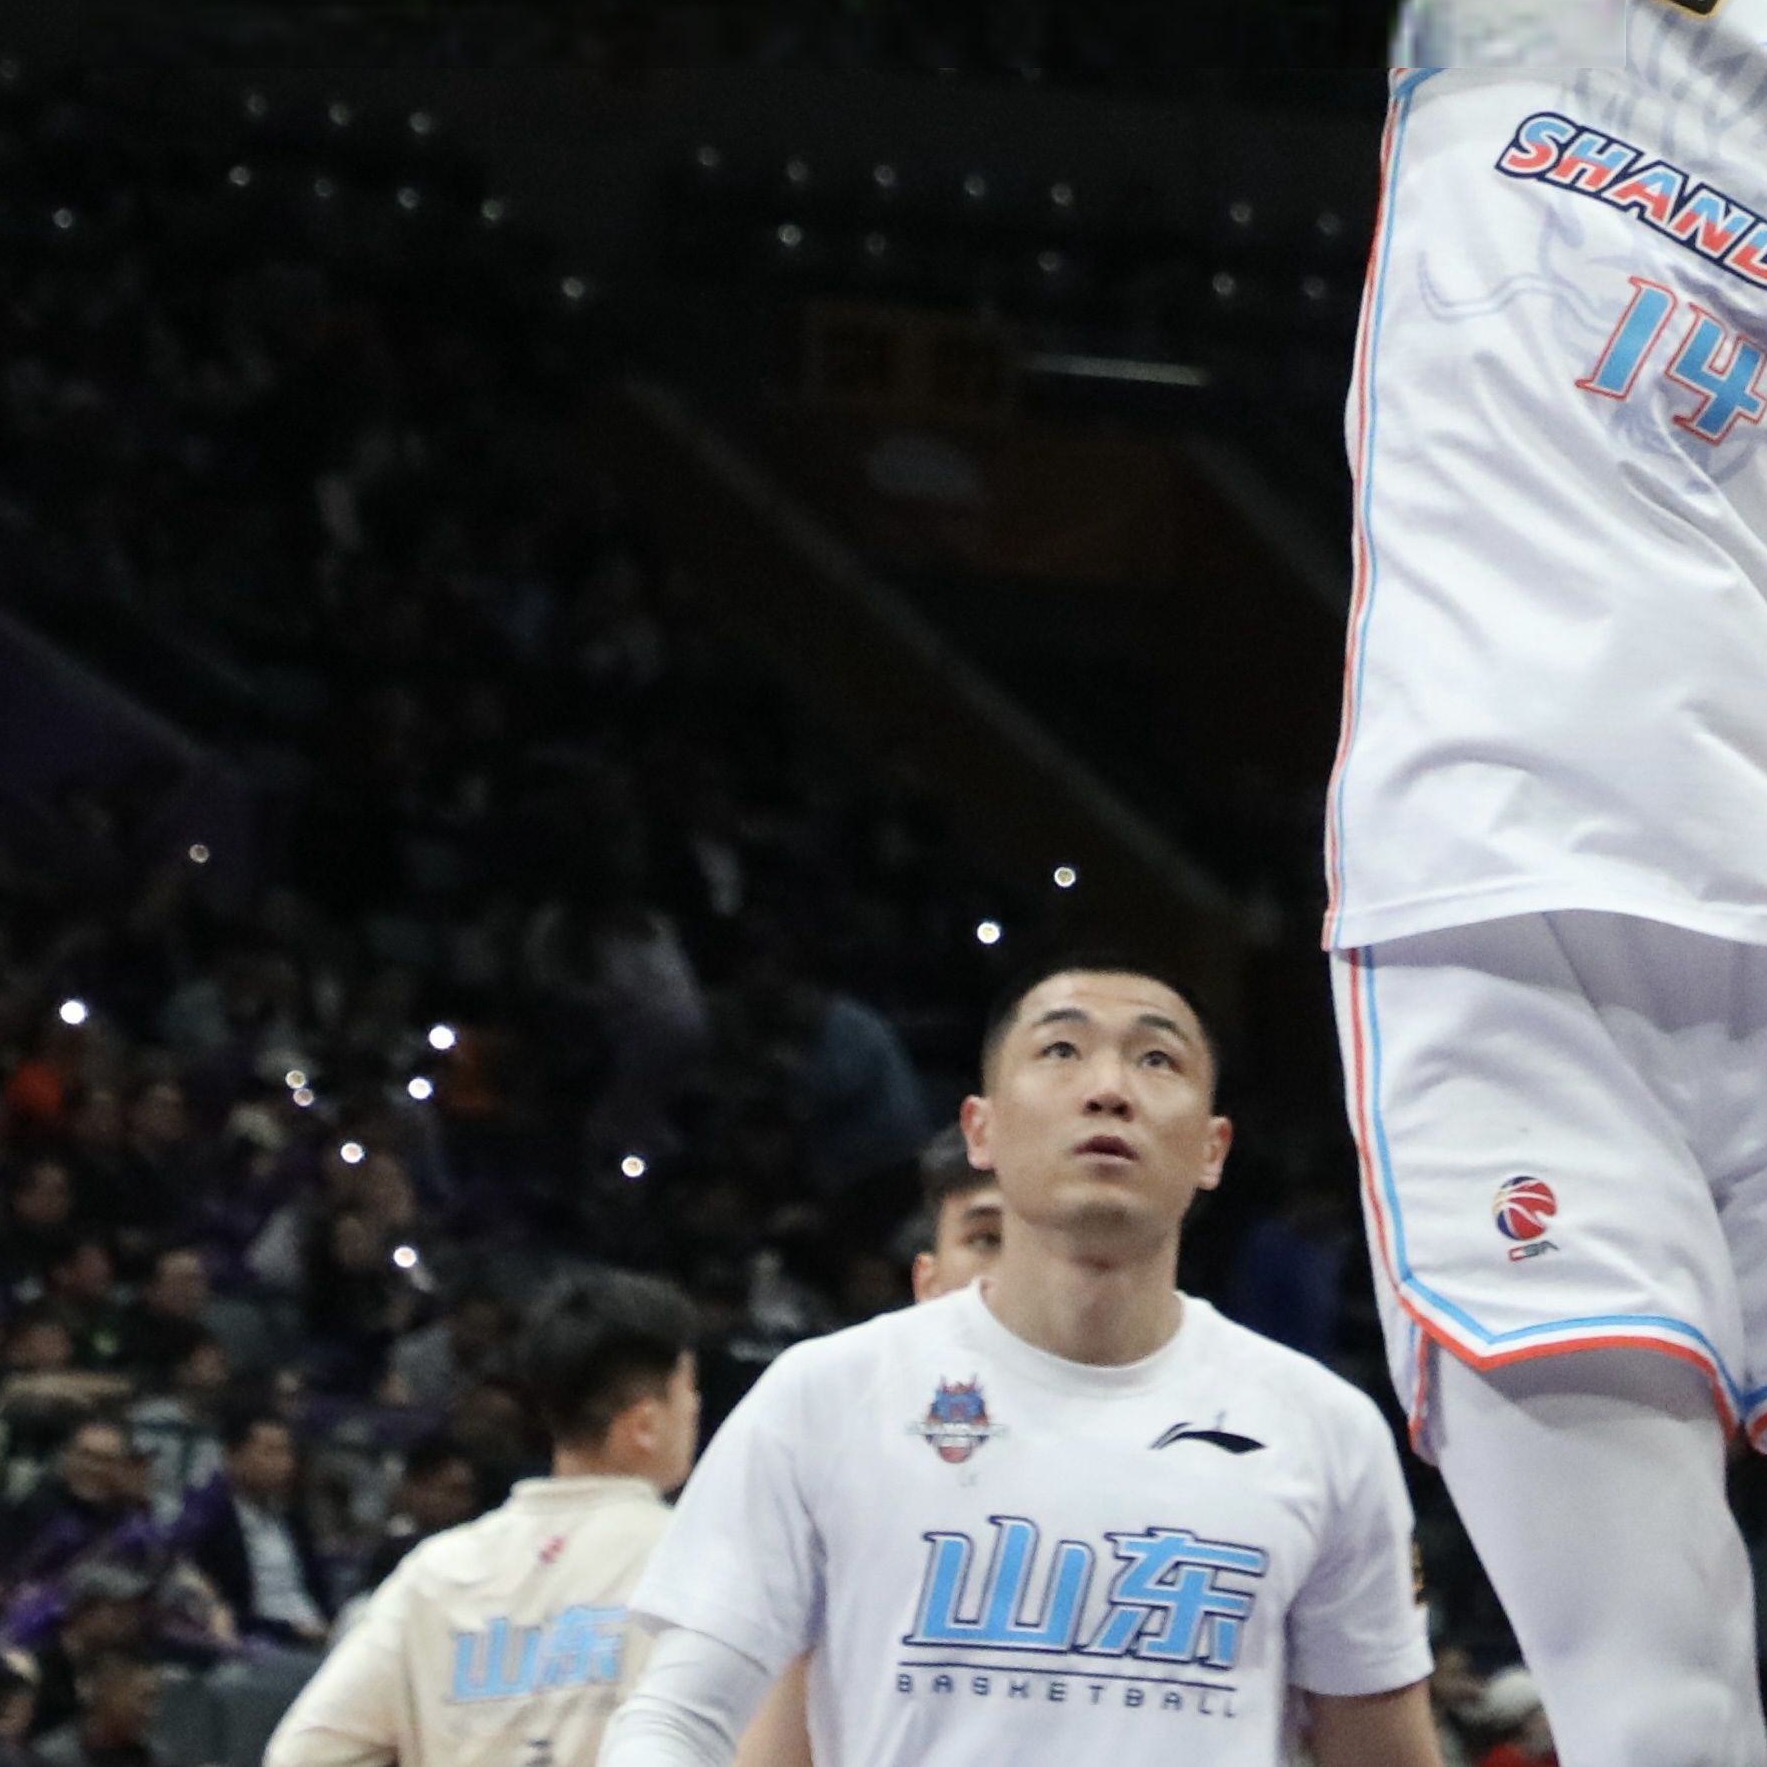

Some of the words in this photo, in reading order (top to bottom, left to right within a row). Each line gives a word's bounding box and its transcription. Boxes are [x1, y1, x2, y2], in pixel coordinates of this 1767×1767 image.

[902, 1515, 1269, 1670] 山东
[446, 1603, 628, 1704] 山东
[898, 1674, 1236, 1718] BASKETBALL
